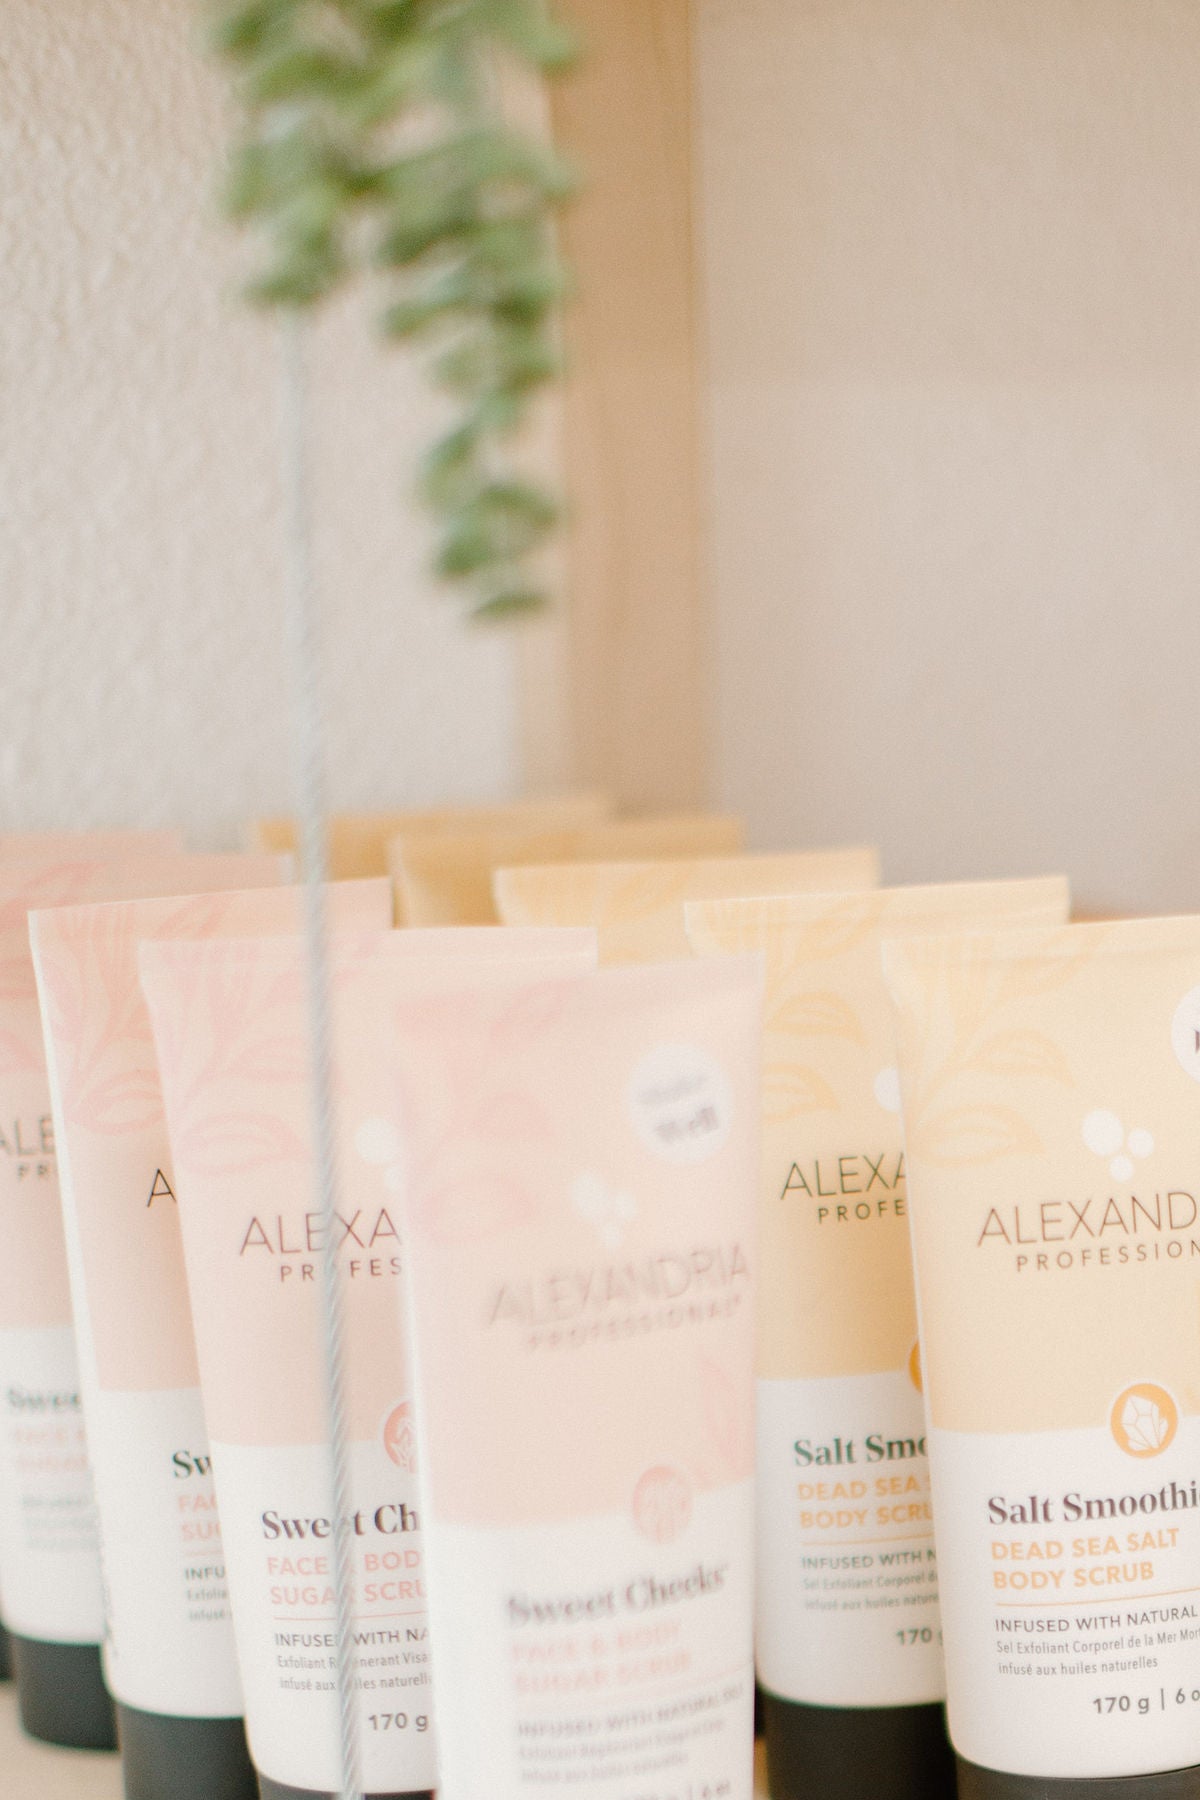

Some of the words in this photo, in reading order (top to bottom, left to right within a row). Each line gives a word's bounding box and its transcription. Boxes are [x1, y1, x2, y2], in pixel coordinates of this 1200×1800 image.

[0, 1115, 55, 1156] LE
[279, 1257, 402, 1283] PRFES
[793, 1436, 857, 1468] Salt
[797, 1480, 868, 1501] DEAD
[874, 1474, 921, 1498] SEA
[800, 1508, 868, 1530] BODY
[987, 1495, 1055, 1526] Salt
[261, 1509, 366, 1541] Swet
[991, 1539, 1063, 1562] DEAD
[1071, 1535, 1121, 1560] SEA
[1126, 1527, 1180, 1552] SALT
[266, 1555, 329, 1577] FACE
[801, 1555, 874, 1570] INFUSED
[880, 1550, 922, 1567] WITH
[992, 1568, 1065, 1591] BODY
[1072, 1560, 1155, 1589] SCRUB
[269, 1584, 356, 1606] SUGA
[994, 1617, 1071, 1634] INFUSED
[1075, 1614, 1122, 1632] WITH
[1126, 1604, 1199, 1628] NATURAL
[353, 1628, 400, 1646] WITH
[896, 1626, 933, 1647] 170
[996, 1640, 1014, 1654] Sel
[1016, 1639, 1070, 1655] Exfoliant
[1072, 1636, 1125, 1656] Corporel
[1127, 1634, 1142, 1650] de
[1157, 1630, 1178, 1646] Mer
[998, 1661, 1033, 1677] infusé
[1036, 1664, 1058, 1677] aux
[1060, 1660, 1098, 1676] huiles
[1101, 1656, 1159, 1673] naturelles
[1093, 1695, 1131, 1715] 170
[1137, 1697, 1151, 1715] g
[1174, 1687, 1187, 1706] 6
[368, 1712, 408, 1731] 170
[415, 1714, 429, 1732] g
